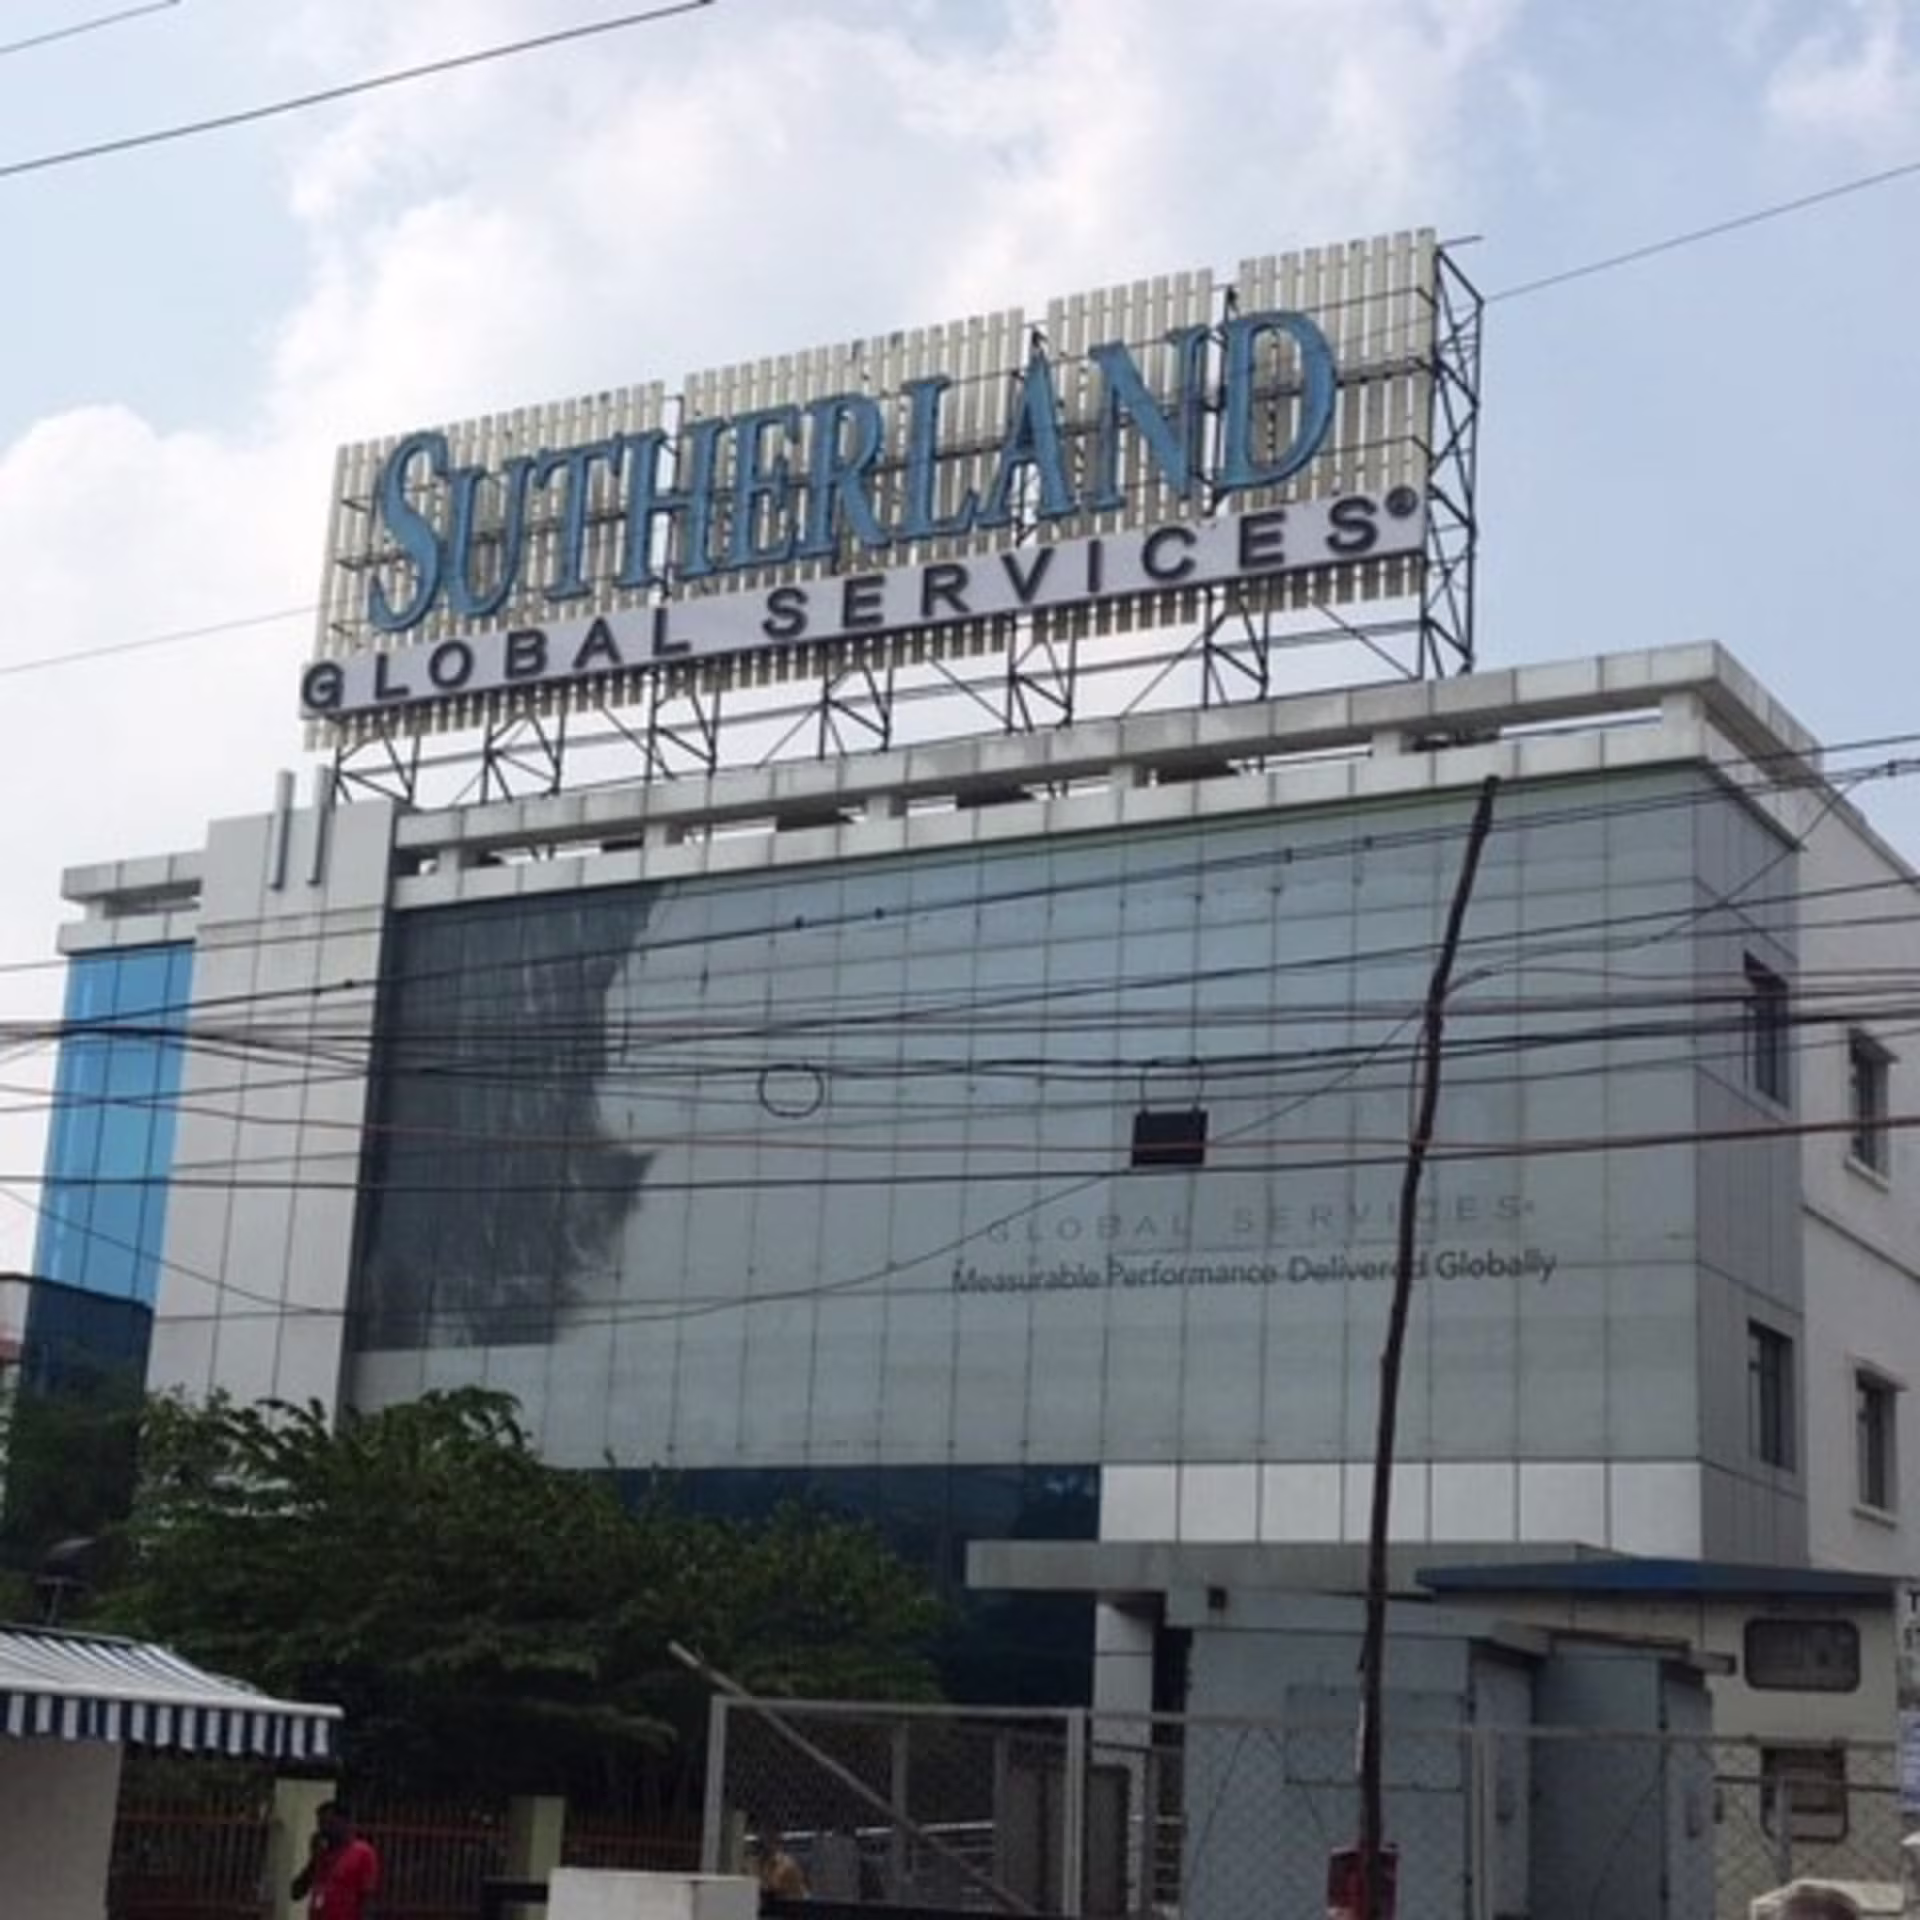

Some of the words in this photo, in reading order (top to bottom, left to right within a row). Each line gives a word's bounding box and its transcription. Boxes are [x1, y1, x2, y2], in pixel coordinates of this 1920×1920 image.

[367, 309, 1337, 634] SUTHERLAND
[301, 606, 692, 710] GLOBAL
[763, 496, 1379, 639] SERVICES
[952, 1262, 1101, 1293] Measurable
[1107, 1253, 1277, 1289] Performance
[1435, 1248, 1556, 1284] Globally
[988, 1213, 1189, 1245] GLOBAL
